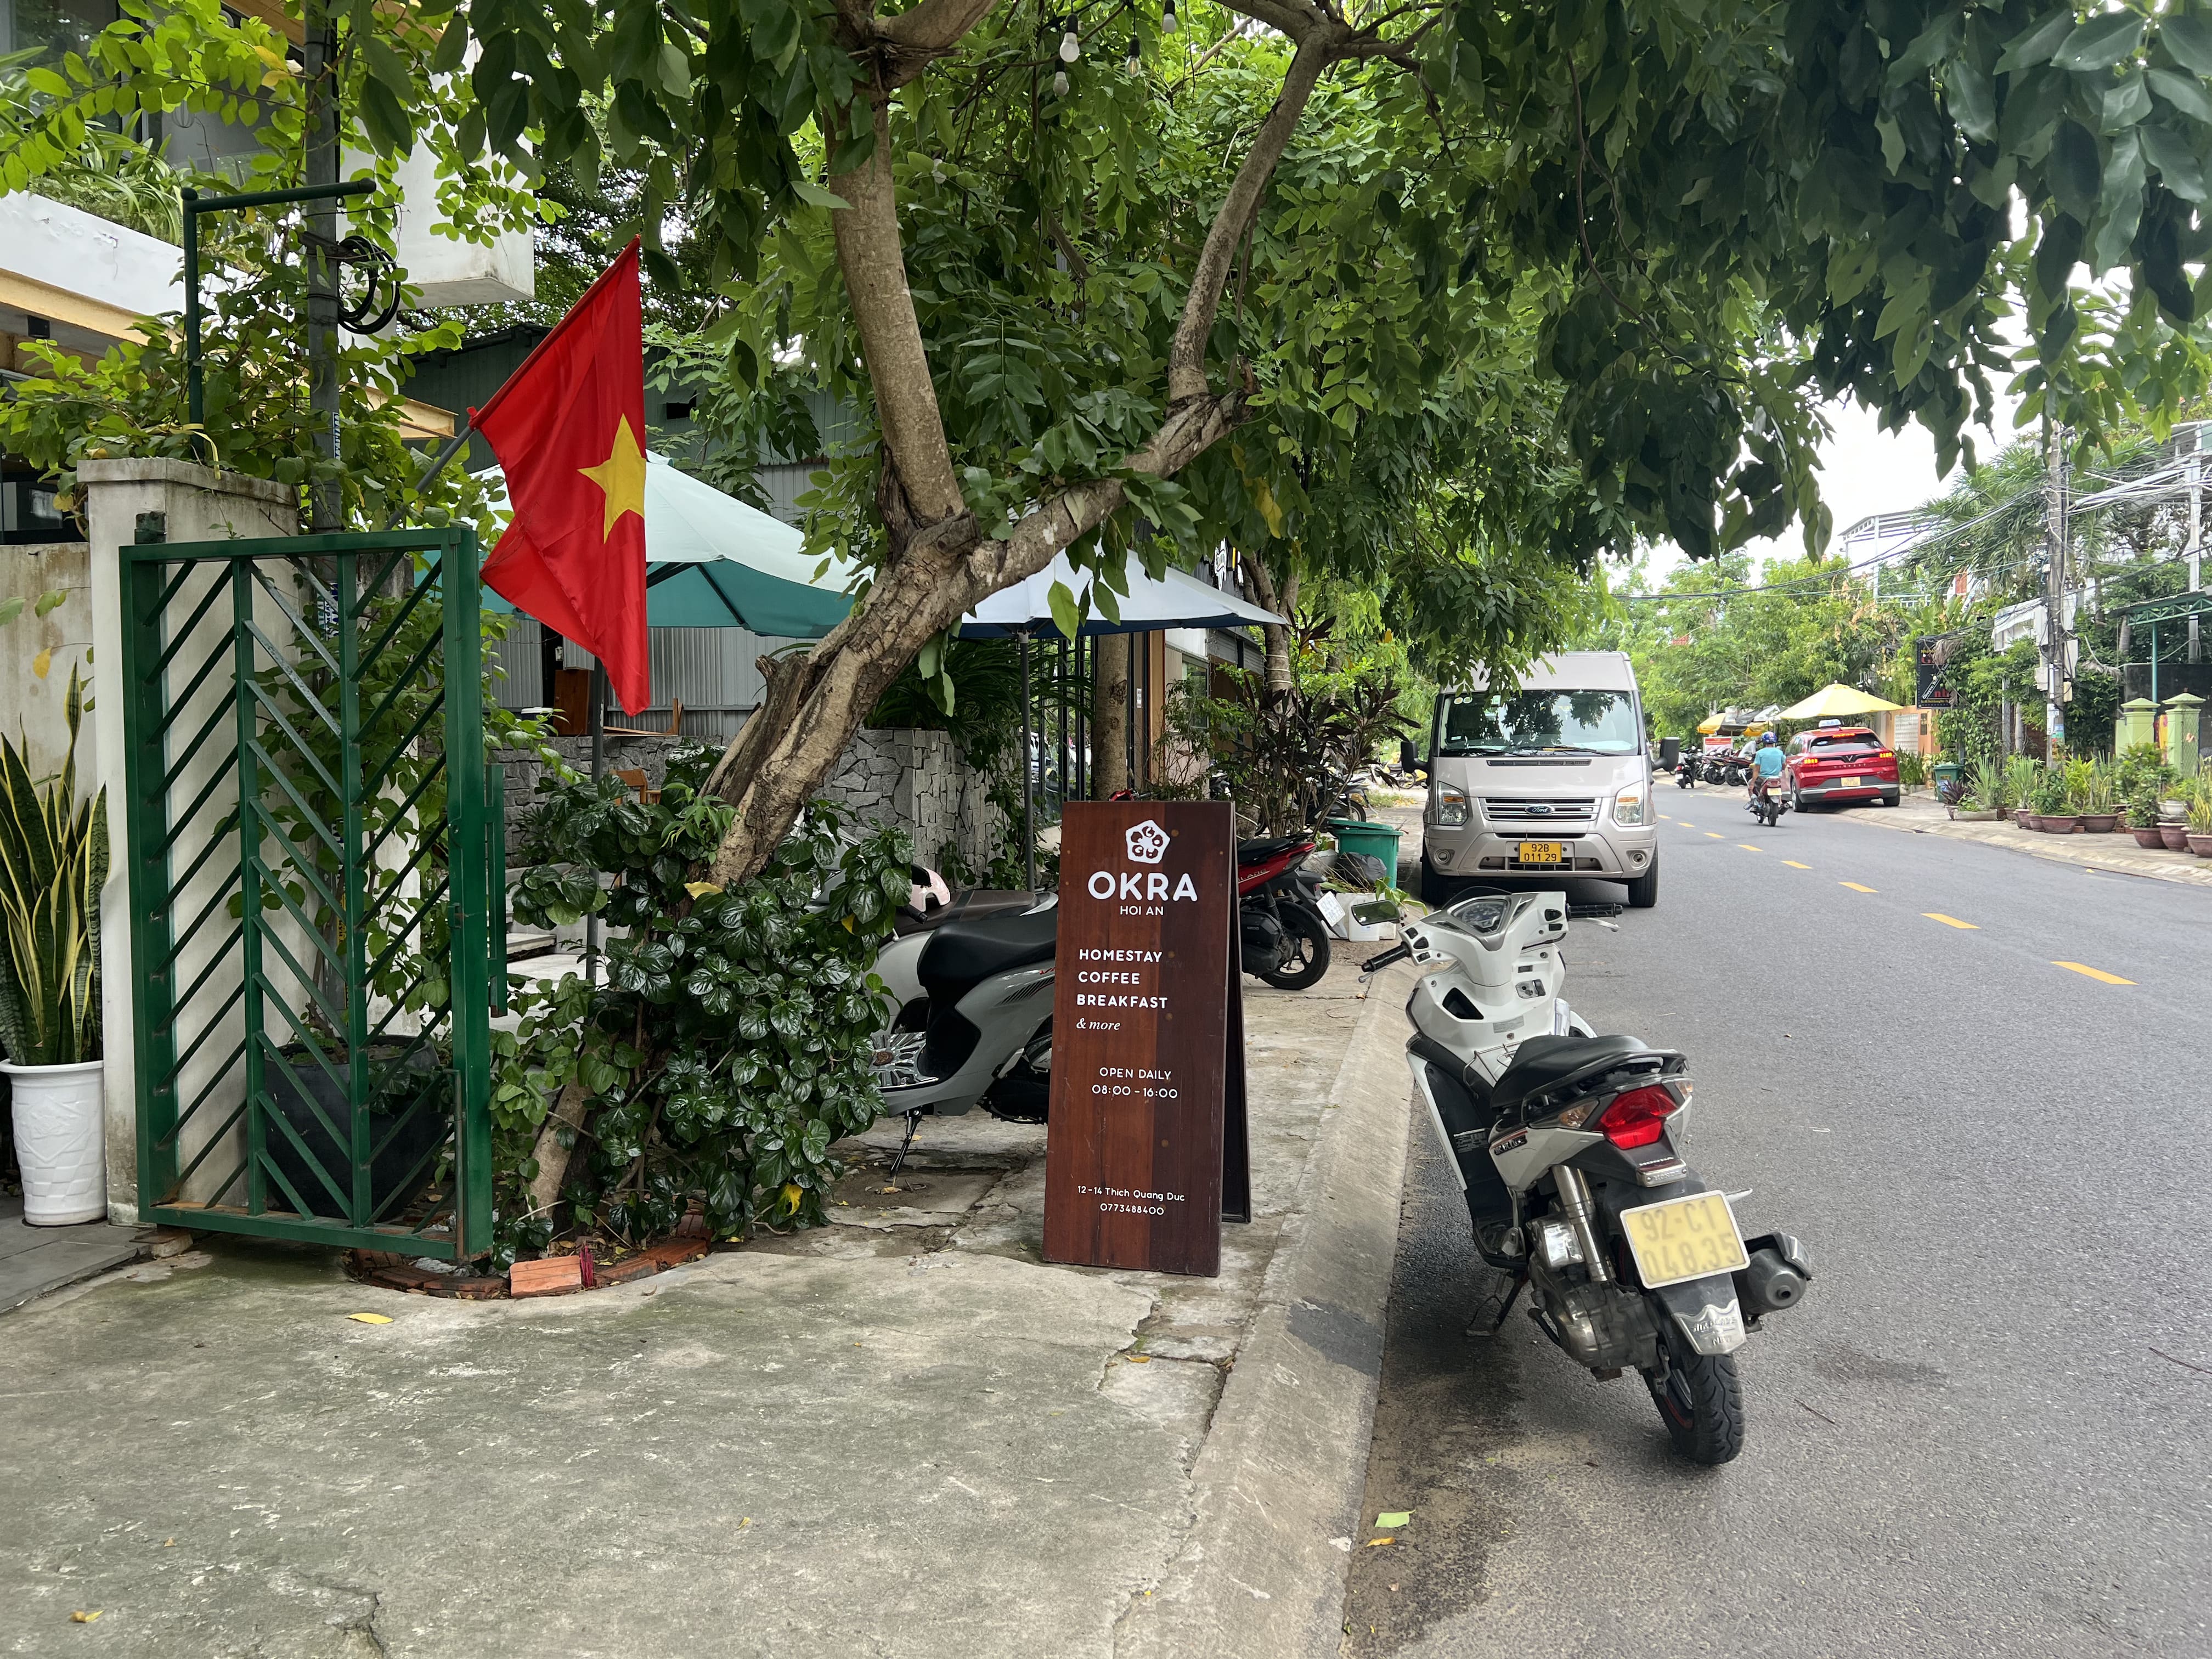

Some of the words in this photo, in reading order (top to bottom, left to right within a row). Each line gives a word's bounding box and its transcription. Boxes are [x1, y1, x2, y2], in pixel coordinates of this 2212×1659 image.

[1531, 844, 1550, 852] 92B
[1524, 853, 1557, 861] 011.29
[1087, 871, 1198, 901] OKRA
[1120, 905, 1142, 916] HOI
[1146, 906, 1164, 916] AN
[1079, 949, 1163, 963] HOMESTAY
[1078, 971, 1140, 984] COFFEE
[1077, 994, 1168, 1009] BREAKFAST
[1076, 1018, 1086, 1029] &
[1089, 1022, 1121, 1030] more
[1099, 1067, 1133, 1078] OPEN
[1138, 1069, 1171, 1080] DAILY
[1092, 1084, 1131, 1096] 08:00
[1143, 1087, 1178, 1099] 16:00
[1105, 1187, 1130, 1197] Thich
[1133, 1189, 1164, 1201] Quang
[1167, 1192, 1185, 1201] Duc
[1100, 1203, 1164, 1215] 0773488400
[1641, 1232, 1741, 1279] 048.35
